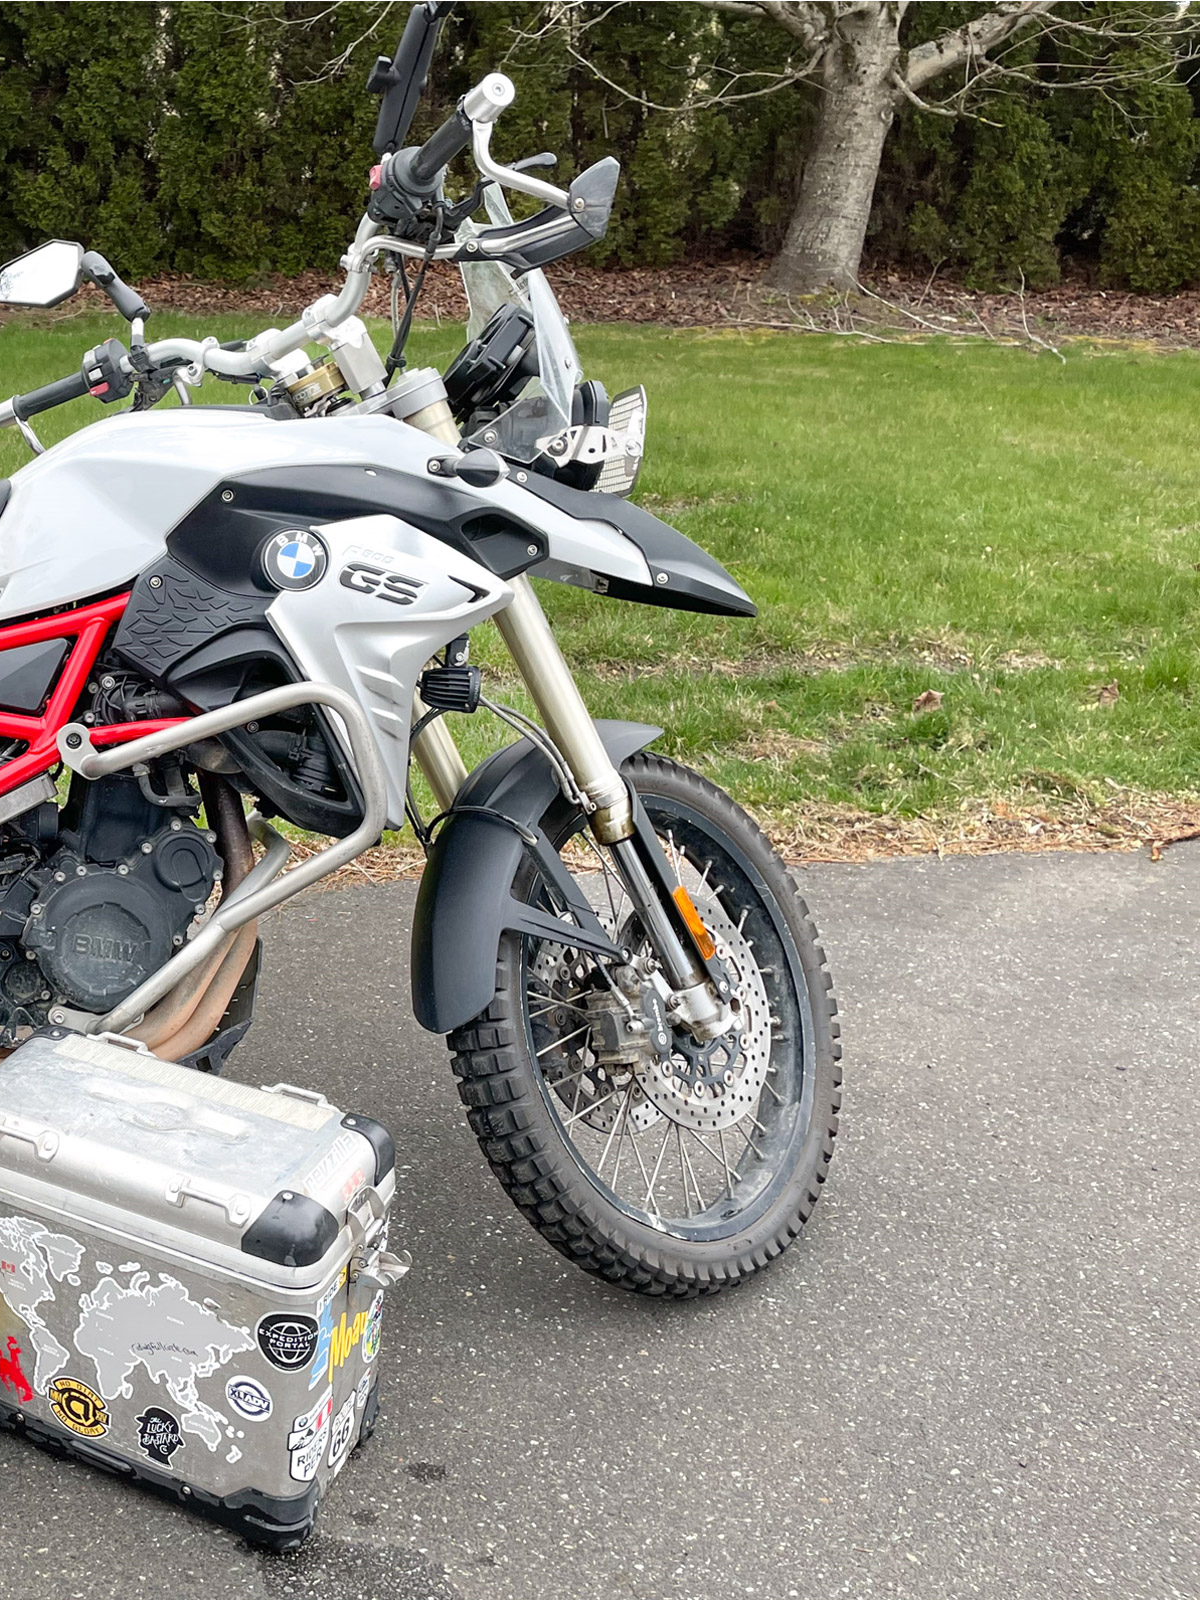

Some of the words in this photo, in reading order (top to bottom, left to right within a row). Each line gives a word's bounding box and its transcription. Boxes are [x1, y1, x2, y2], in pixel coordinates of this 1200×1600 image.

[276, 532, 325, 556] BMW
[339, 561, 425, 606] GS
[73, 933, 139, 963] BMW
[258, 1328, 319, 1343] EXPEDITION
[269, 1338, 311, 1349] PORTAL
[146, 1420, 175, 1434] LUCKY
[332, 1416, 351, 1458] 66
[142, 1432, 180, 1450] BASTARD
